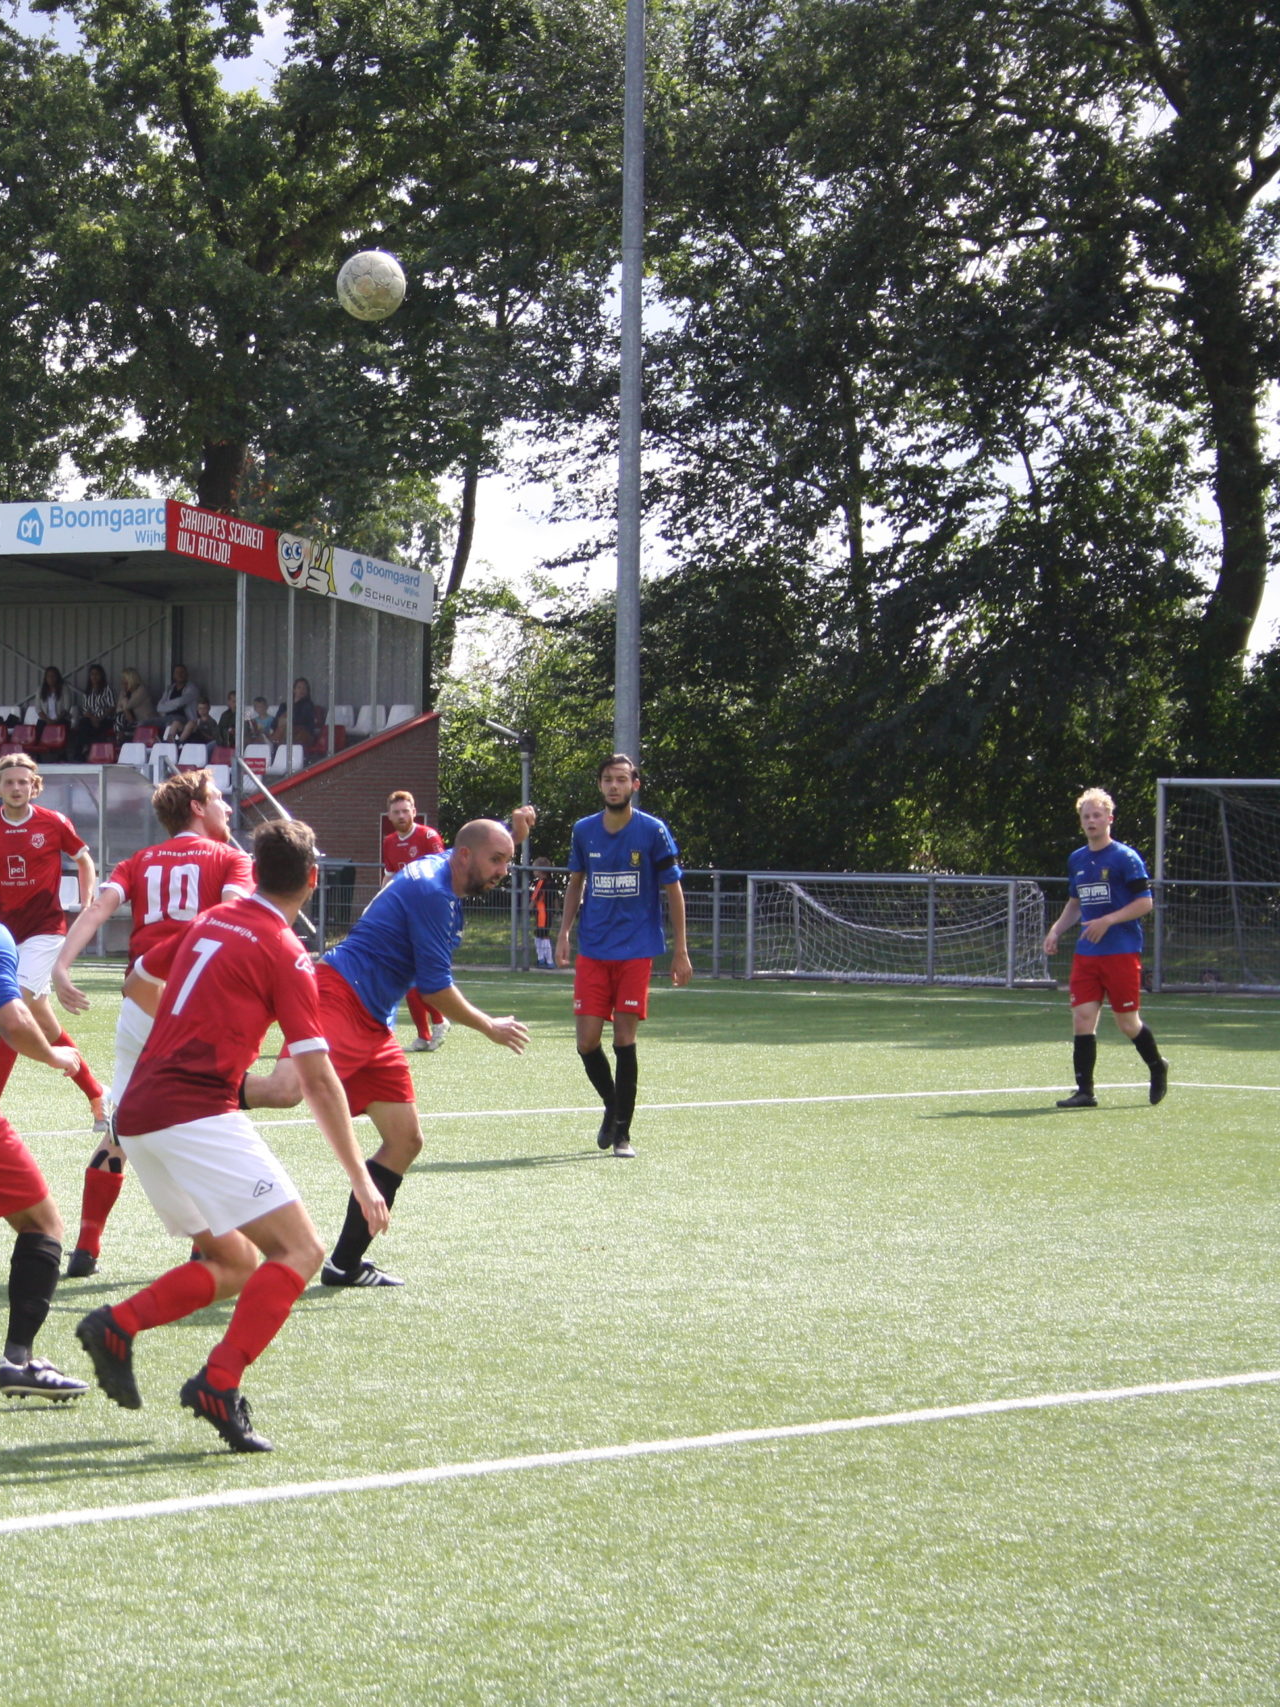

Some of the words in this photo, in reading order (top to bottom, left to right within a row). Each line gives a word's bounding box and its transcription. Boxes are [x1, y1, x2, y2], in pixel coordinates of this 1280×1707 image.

[134, 530, 167, 546] Wijhe
[179, 507, 227, 540] SAAMPIES
[228, 522, 264, 551] SCOREN
[177, 531, 196, 554] WIJ
[197, 536, 232, 565] ALTIJD!
[365, 561, 421, 587] Boomgaard
[364, 587, 419, 610] SCHRIJVER
[144, 863, 200, 925] 10
[171, 938, 223, 1016] 7
